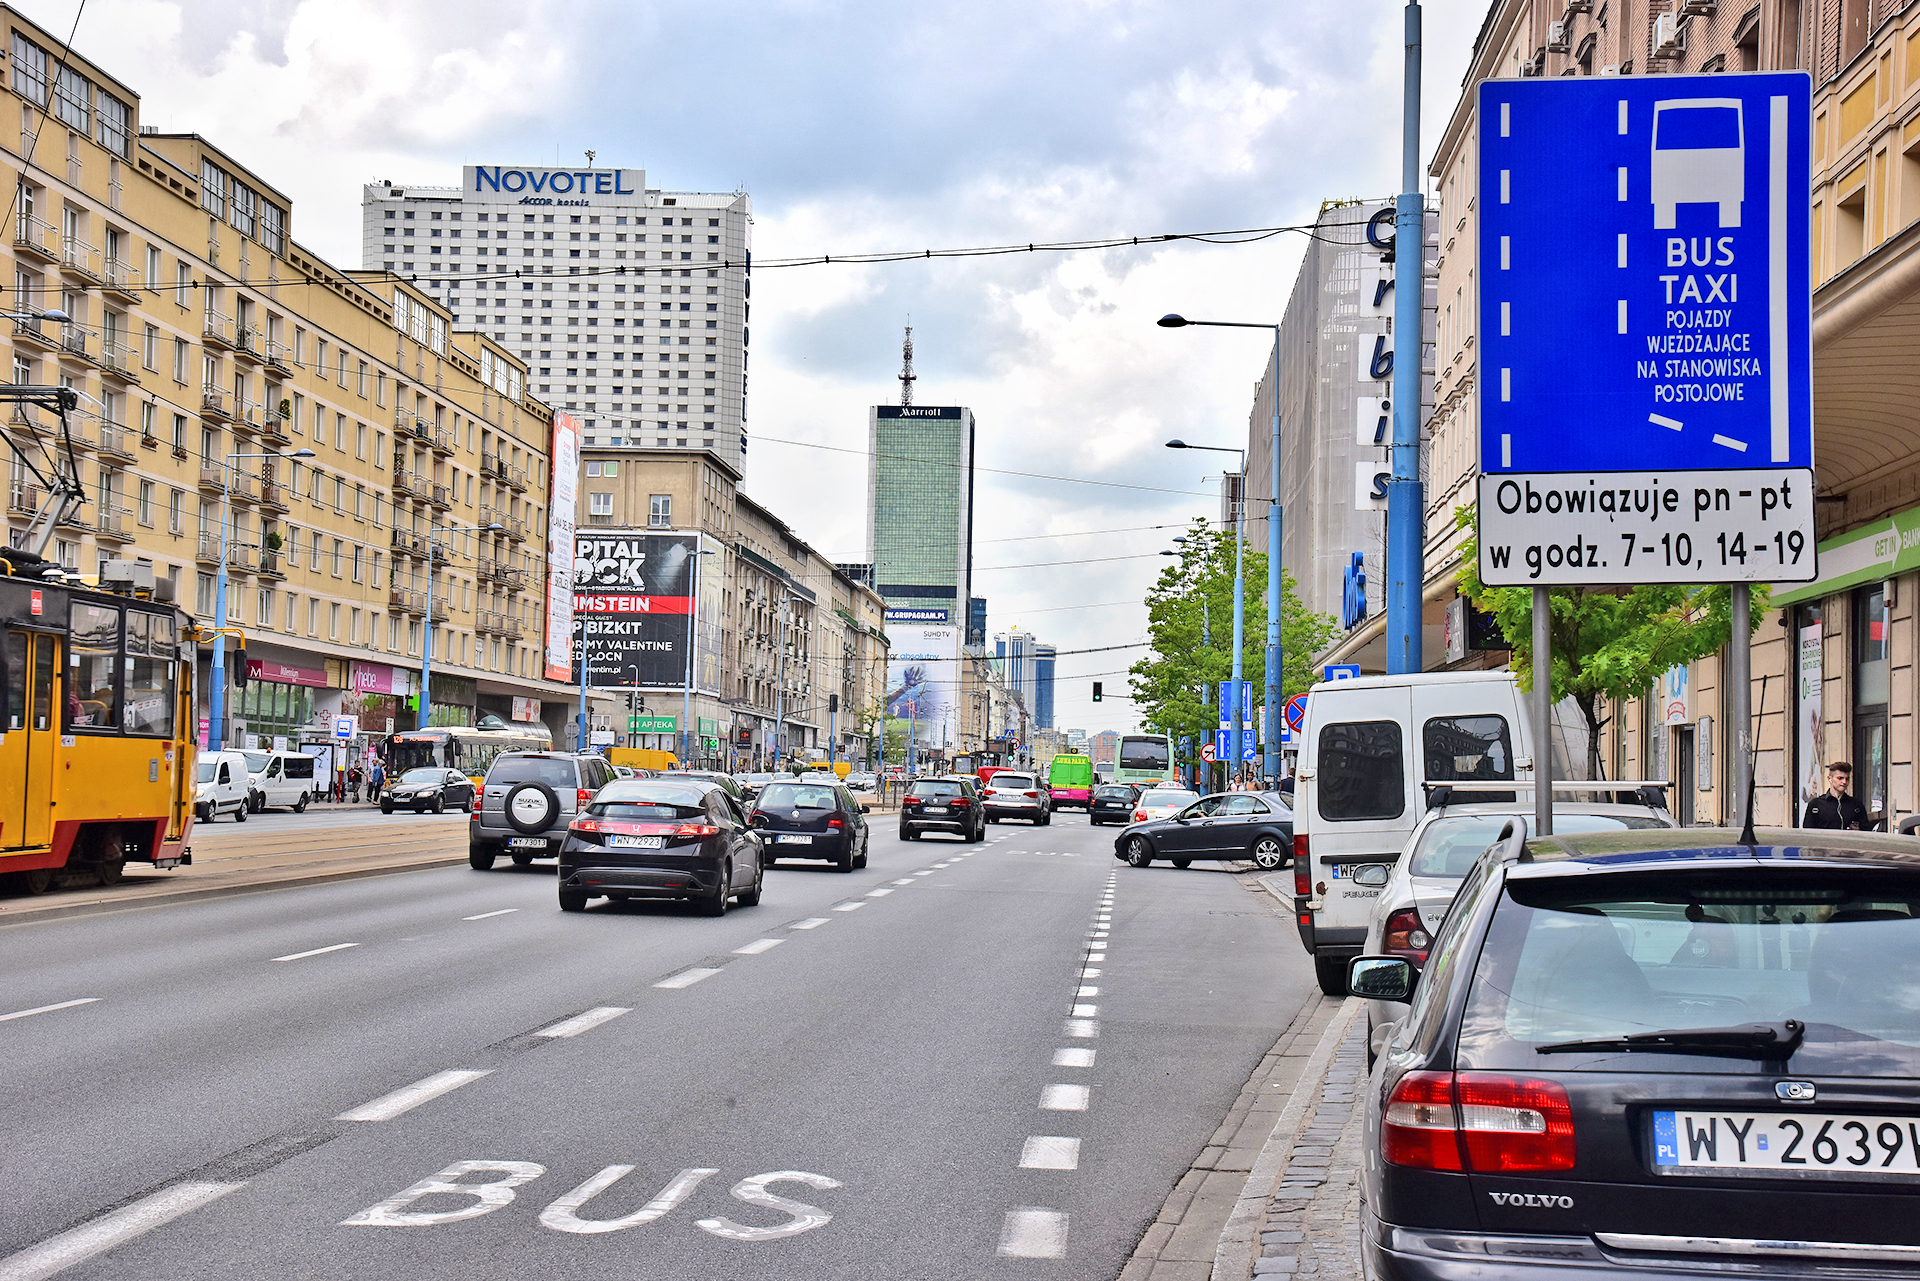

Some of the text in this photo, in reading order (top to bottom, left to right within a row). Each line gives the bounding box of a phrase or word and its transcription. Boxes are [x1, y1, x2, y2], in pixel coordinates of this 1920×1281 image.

[476, 166, 634, 195] NOVOTEL
[557, 198, 589, 207] hotels
[1668, 237, 1734, 267] BUS
[1660, 274, 1736, 305] TAXI
[1666, 310, 1731, 329] POJAZDY
[1647, 330, 1750, 357] WJEŻDŻAJĄCE
[1637, 358, 1761, 379] NA STANOWISKA
[1655, 383, 1744, 403] POSTOJOWE
[1497, 479, 1679, 523] Obowiązuje
[575, 540, 646, 558] PITAL
[1490, 545, 1511, 569] w
[1526, 534, 1607, 579] godz.
[1875, 538, 1888, 558] GET
[1889, 535, 1897, 554] IN
[574, 596, 650, 612] MSTEIN
[586, 621, 642, 635] BIZKIT
[587, 640, 604, 650] MY
[607, 641, 673, 651] VALENTINE
[358, 666, 377, 689] hebe
[641, 720, 673, 729] APTEKA
[616, 836, 660, 847] WN 72923
[1342, 891, 1381, 899] PEUGE
[1685, 1117, 1755, 1162] WY
[1657, 1144, 1675, 1158] PL
[337, 1159, 844, 1241] BUS
[1488, 1192, 1574, 1209] VOLVO
